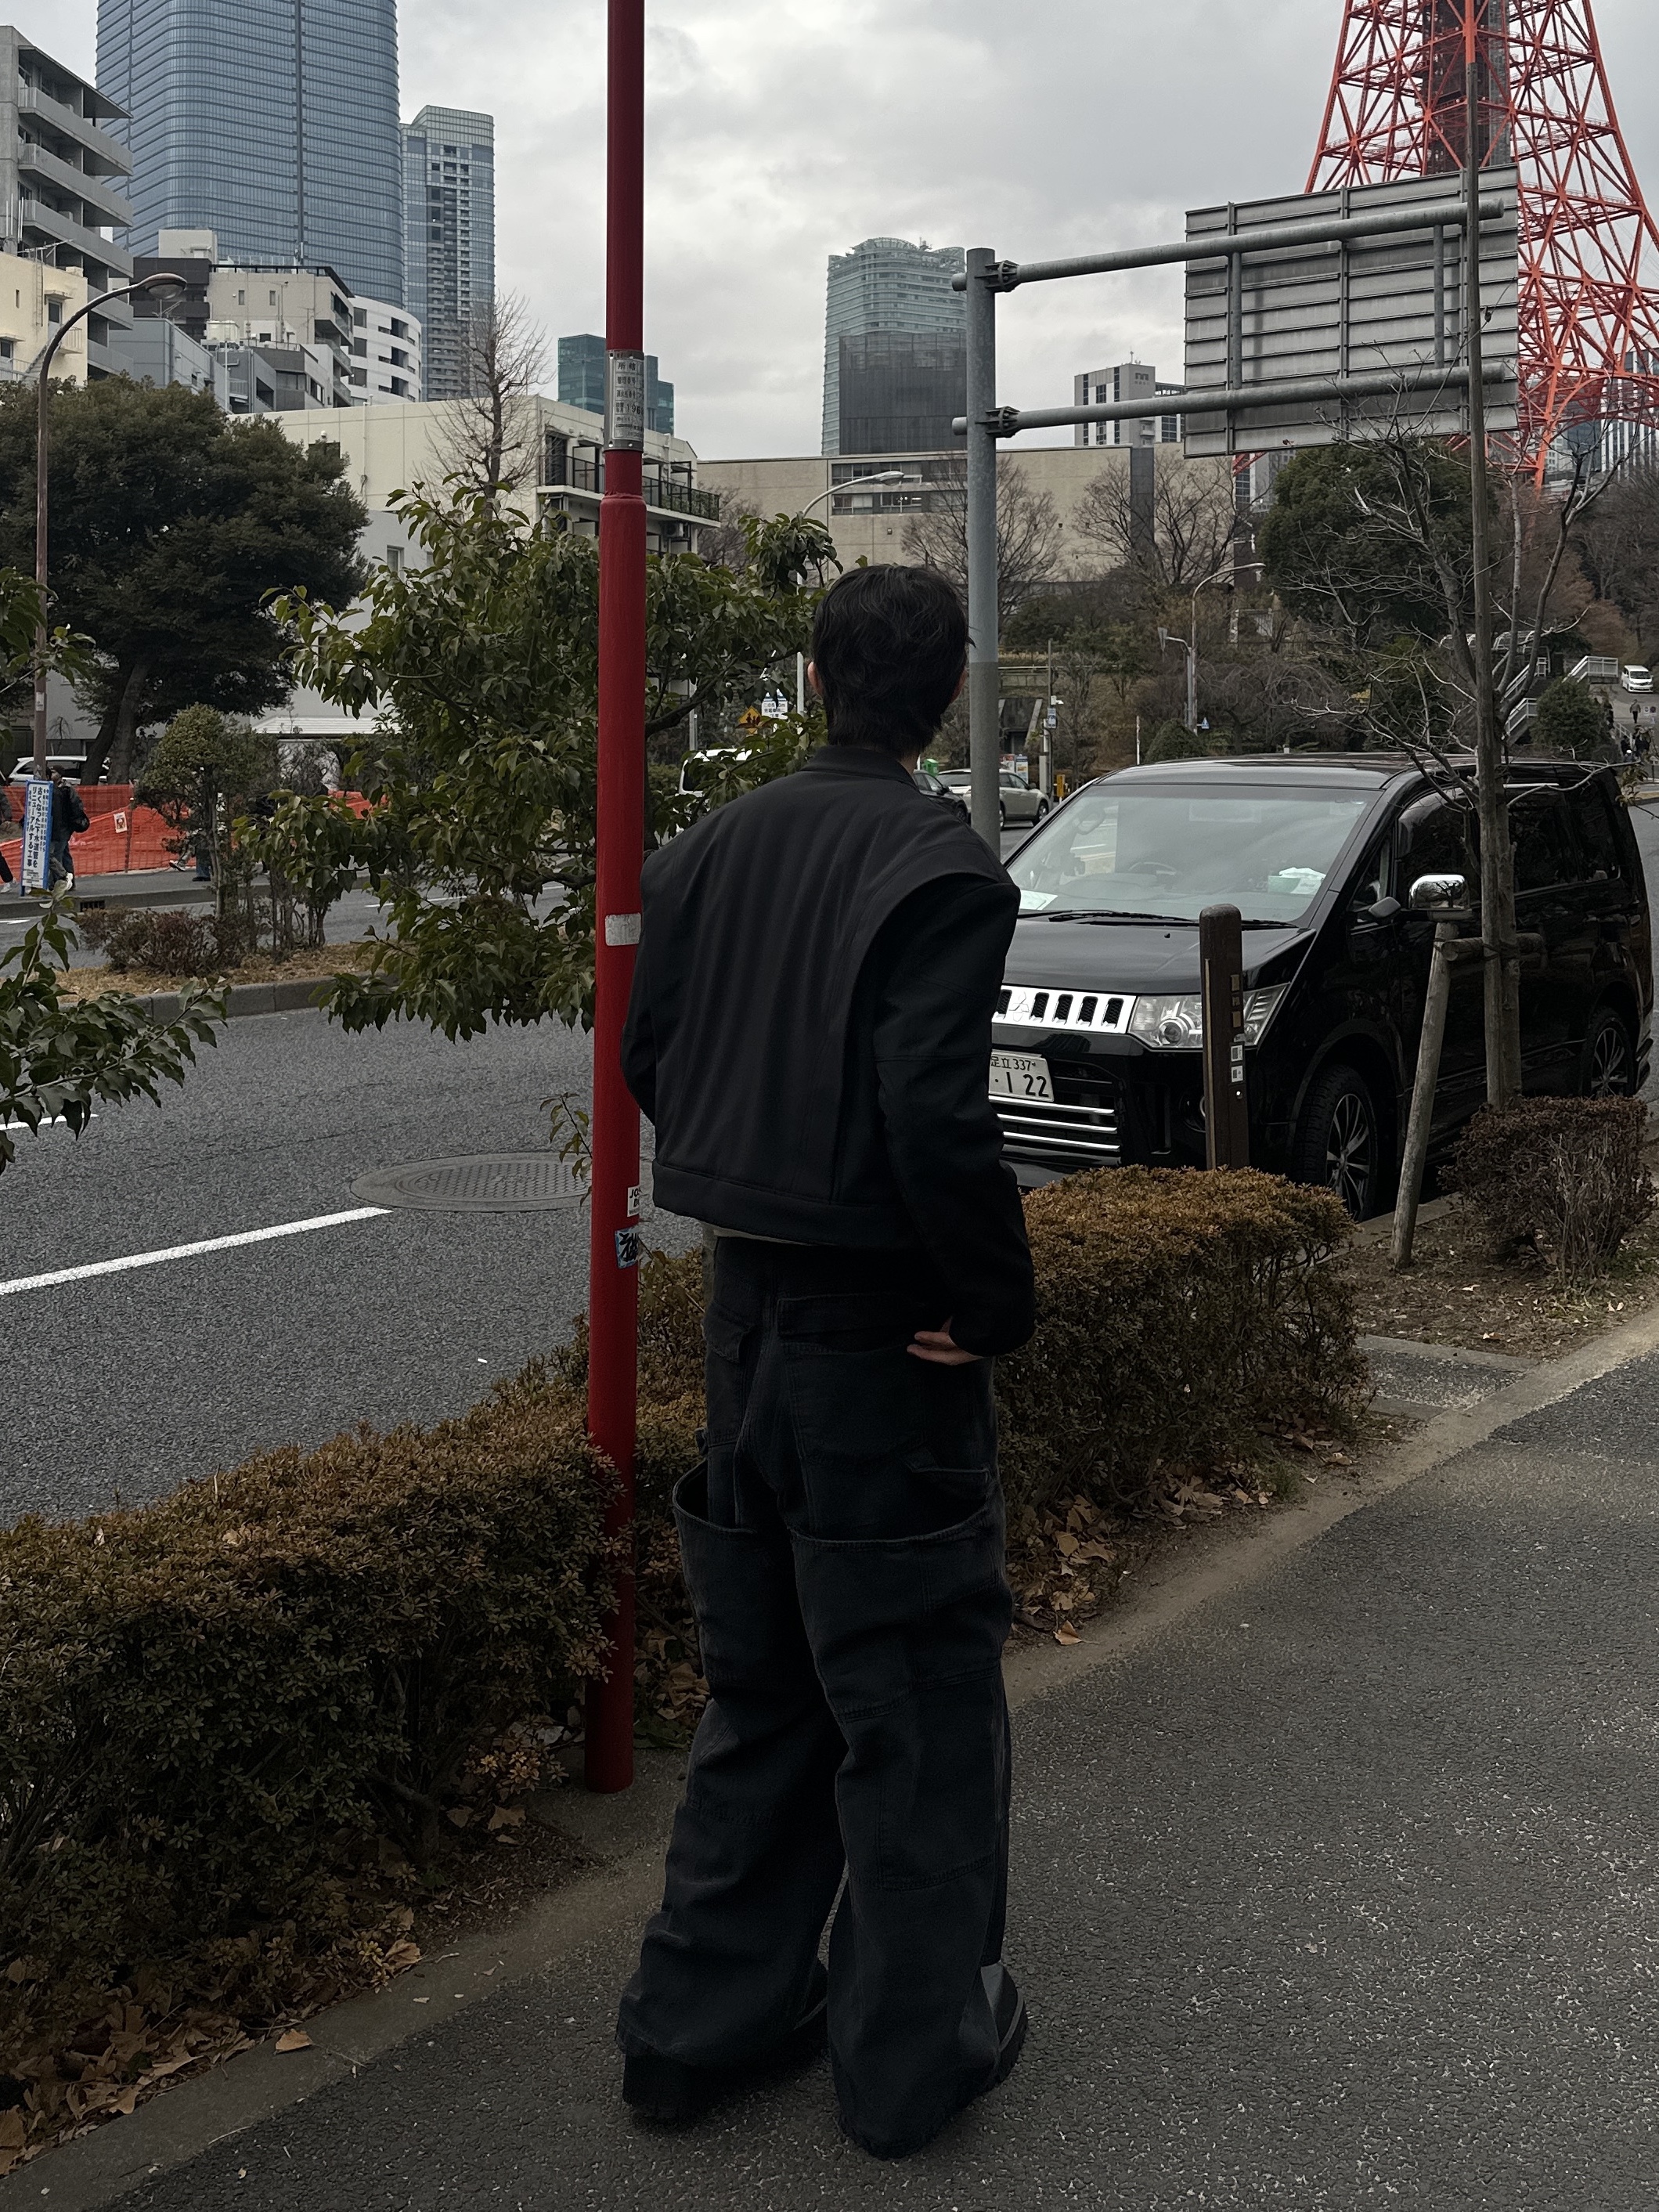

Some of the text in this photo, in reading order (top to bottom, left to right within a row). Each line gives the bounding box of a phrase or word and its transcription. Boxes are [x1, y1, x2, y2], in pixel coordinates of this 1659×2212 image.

[27, 787, 37, 867] リニューアルする工事
[33, 786, 42, 868] 古くなった下水道管を
[991, 1055, 1031, 1071] 足立 337
